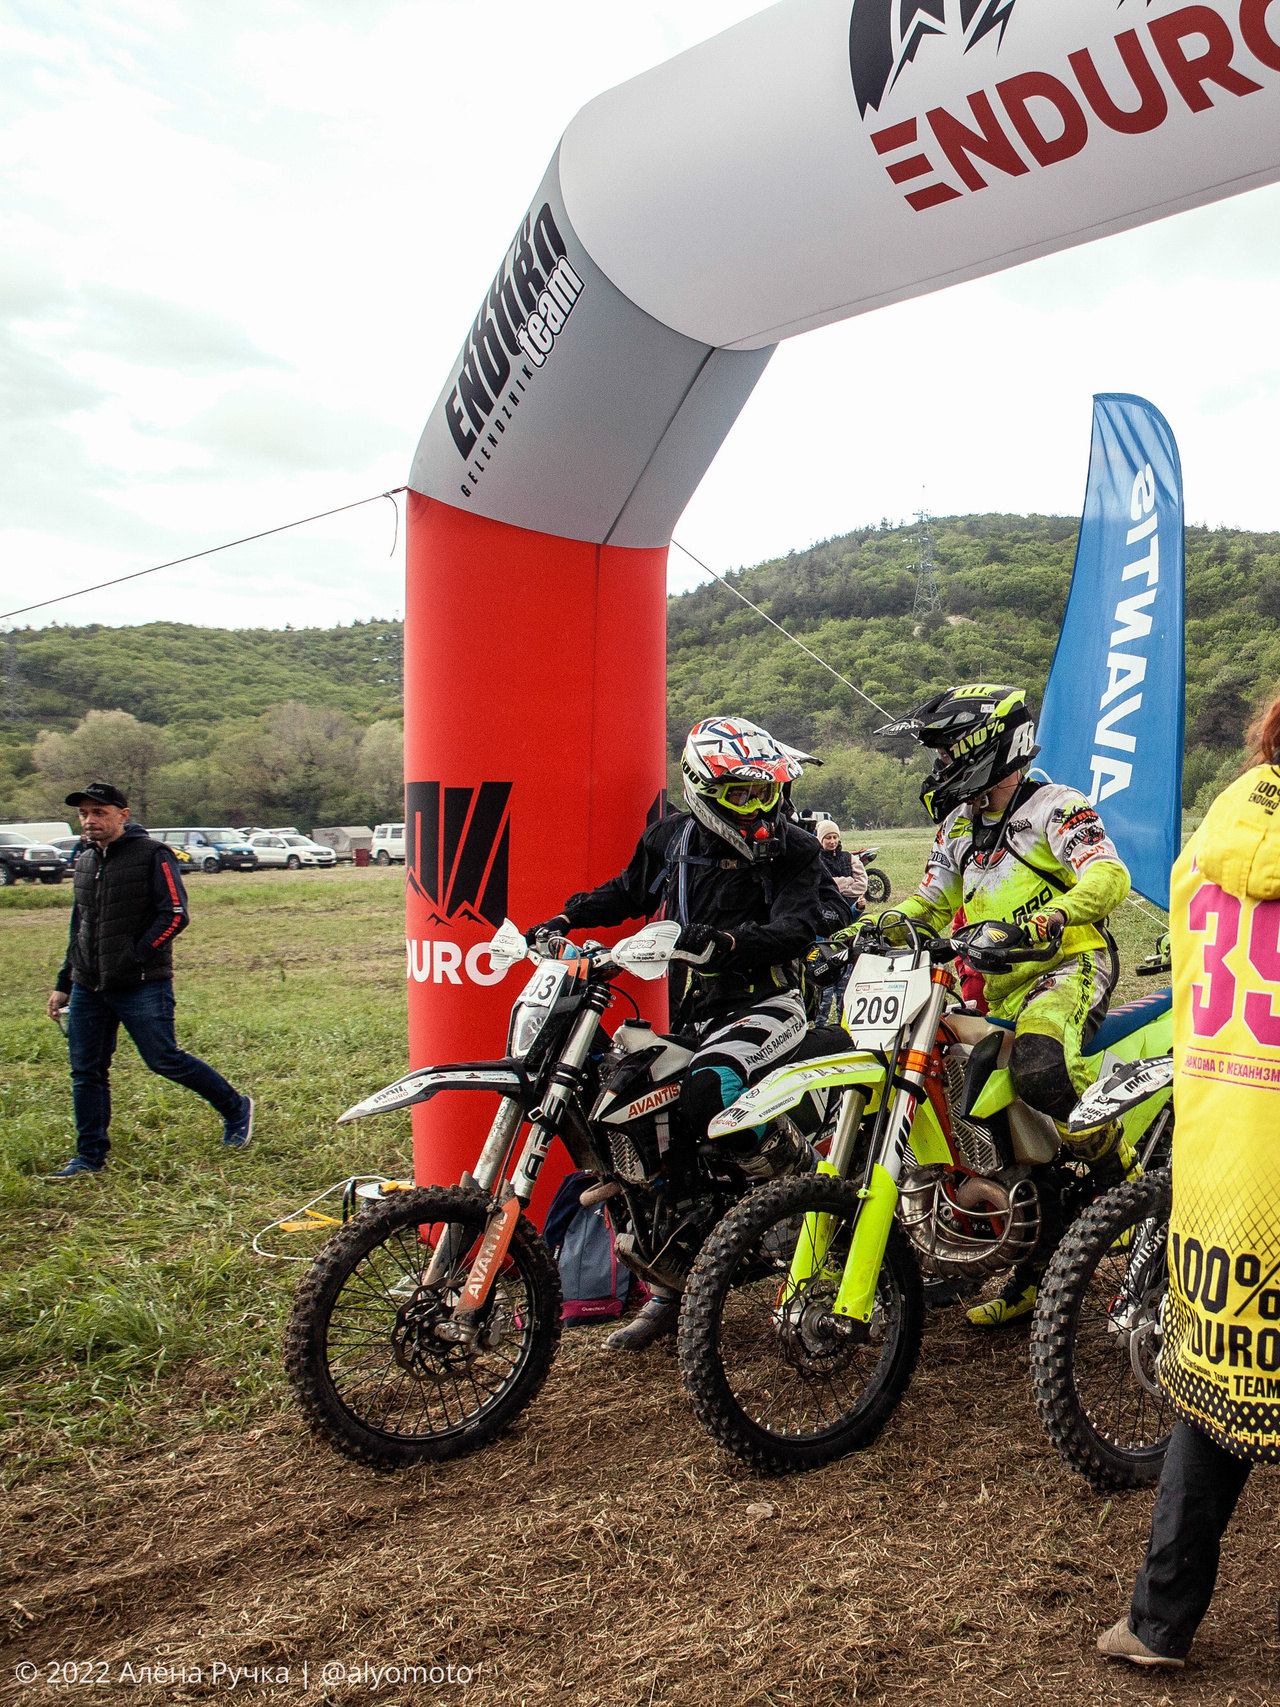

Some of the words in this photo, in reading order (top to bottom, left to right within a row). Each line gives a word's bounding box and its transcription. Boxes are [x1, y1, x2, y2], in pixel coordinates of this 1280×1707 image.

[515, 255, 586, 369] team
[460, 364, 534, 498] GELENDZHIK
[682, 760, 718, 795] 00%
[735, 765, 770, 781] Airoh
[1248, 793, 1280, 811] ENDURO
[851, 995, 899, 1026] 209
[1218, 1060, 1225, 1073] С
[627, 1083, 682, 1118] AVANTIS
[467, 1212, 508, 1299] AVANTIS
[1234, 1375, 1280, 1399] TEAM
